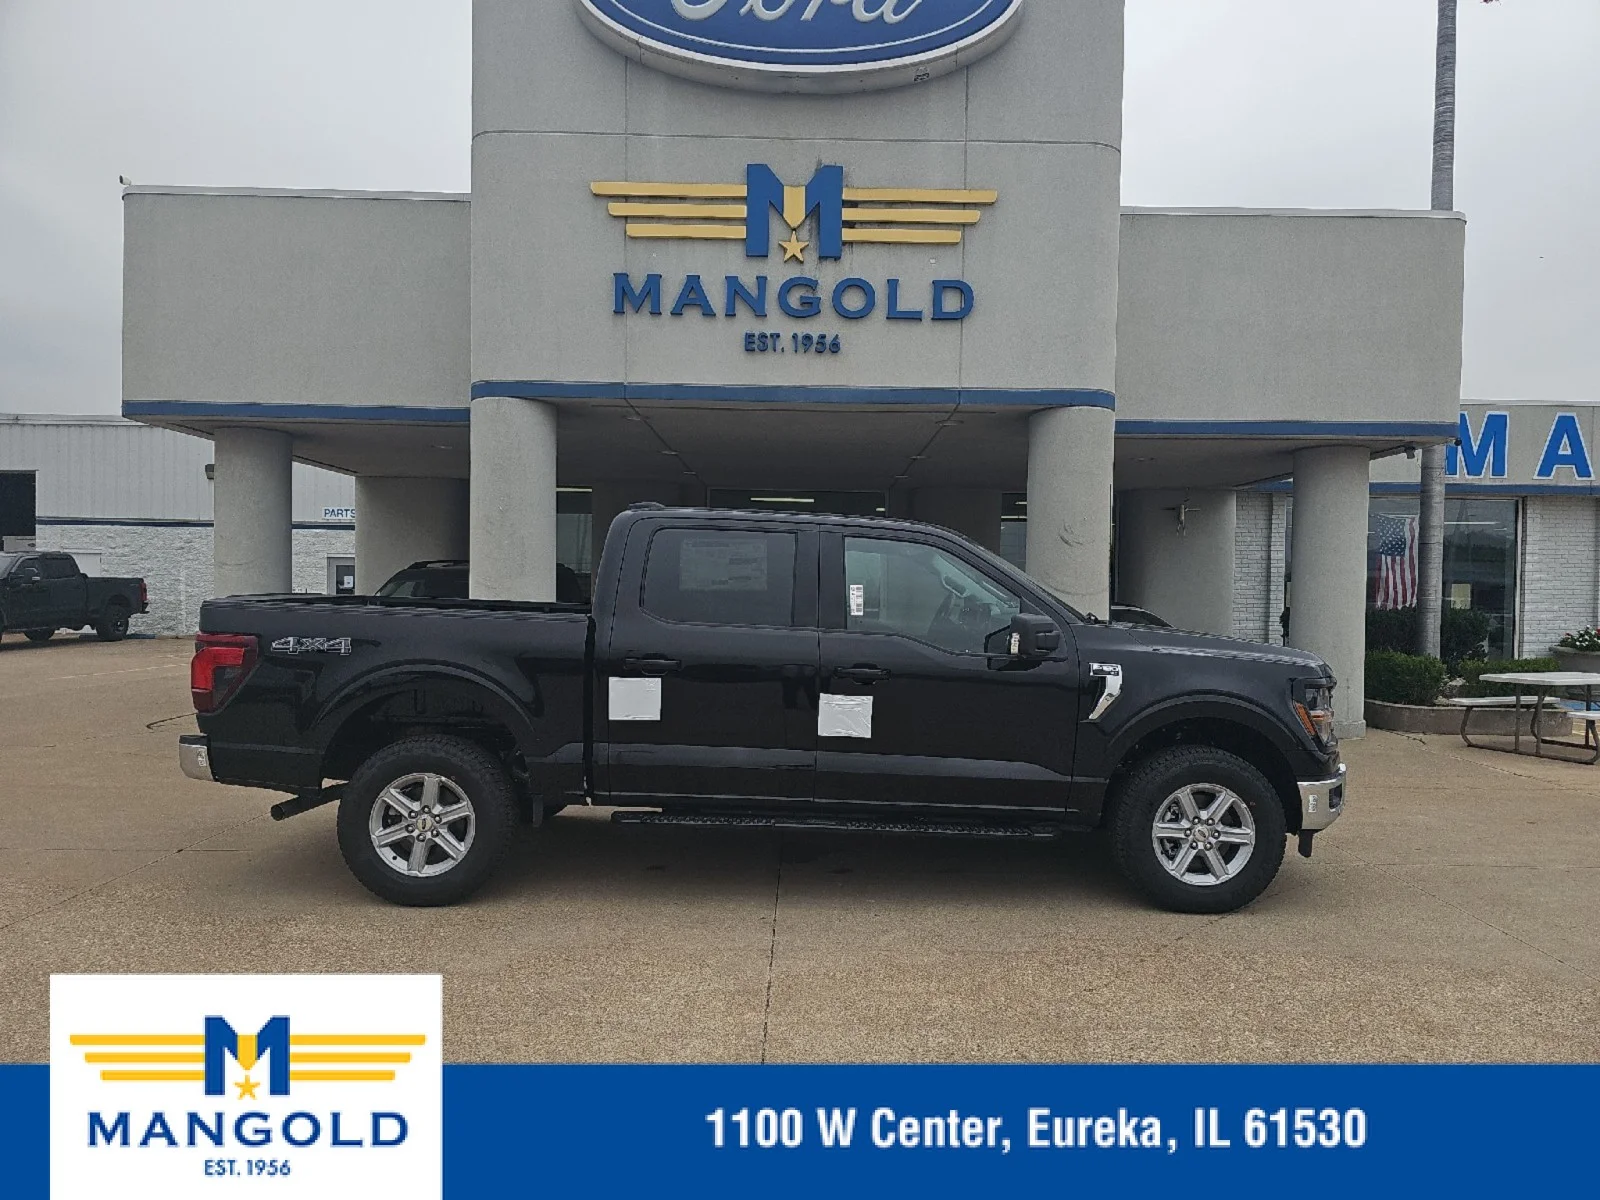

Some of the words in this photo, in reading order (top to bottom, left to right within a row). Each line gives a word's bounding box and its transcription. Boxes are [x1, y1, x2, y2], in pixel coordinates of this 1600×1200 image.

[612, 272, 975, 321] MANGOLD
[743, 332, 785, 353] EST.
[792, 332, 841, 354] 1956
[324, 508, 355, 518] PARTS
